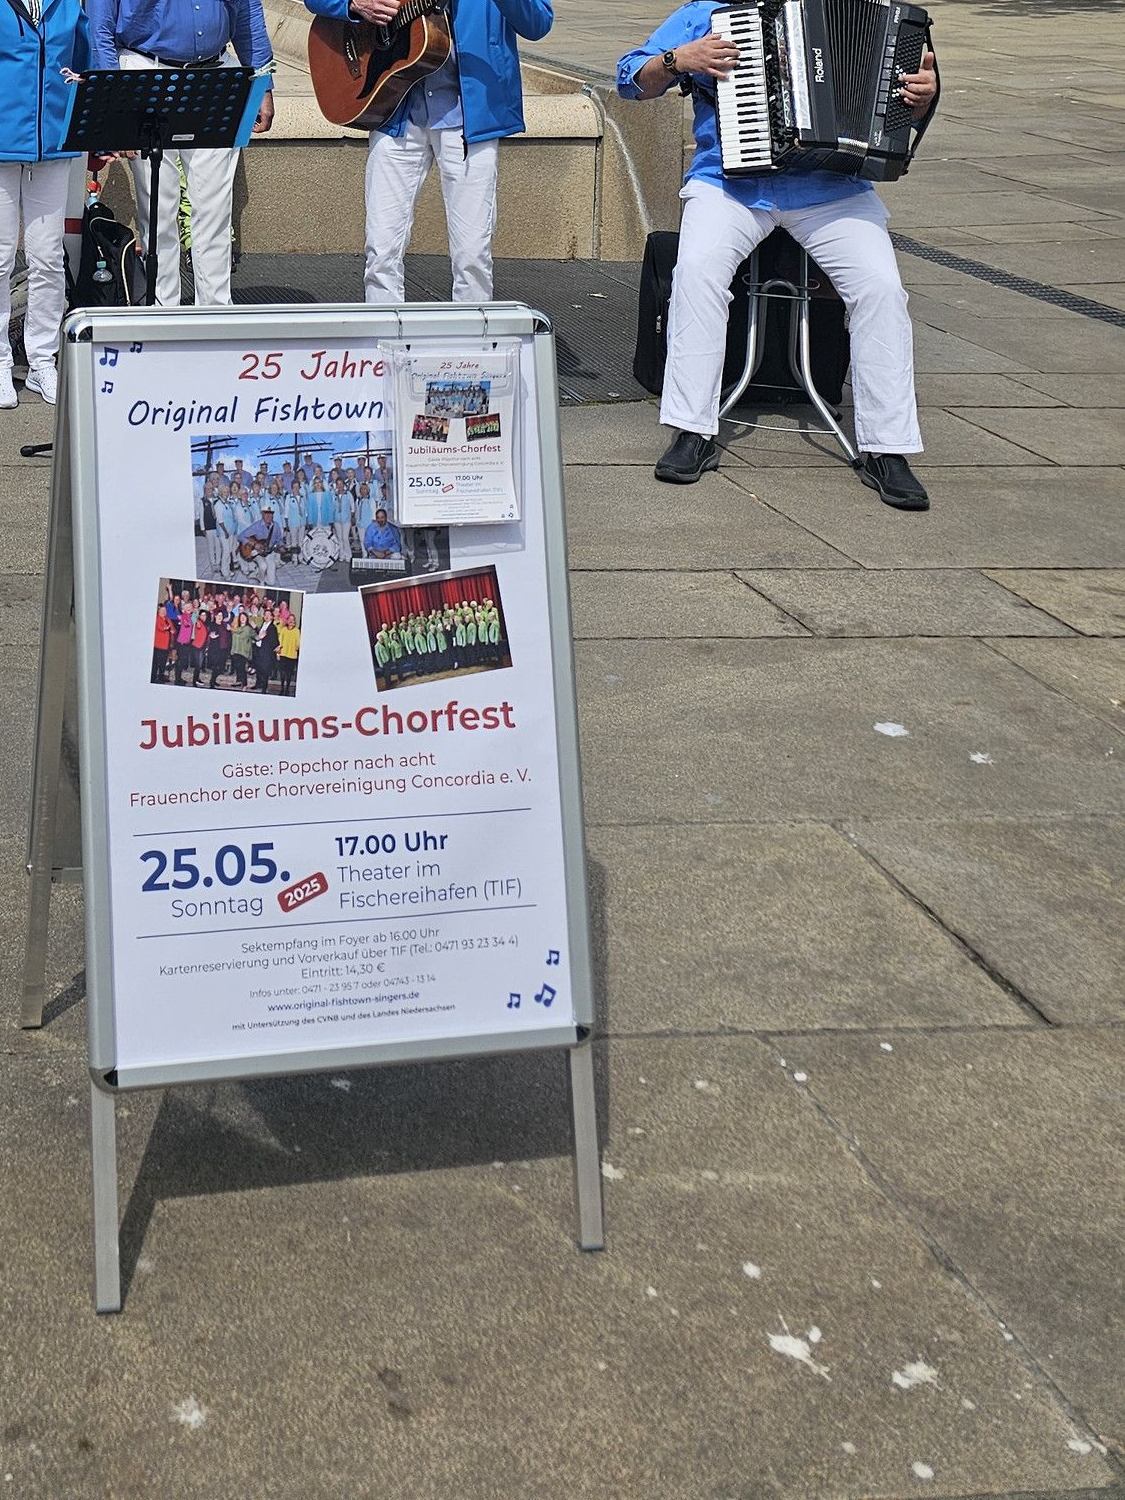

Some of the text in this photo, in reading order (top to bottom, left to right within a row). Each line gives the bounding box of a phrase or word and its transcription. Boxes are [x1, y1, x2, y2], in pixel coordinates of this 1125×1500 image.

[811, 47, 825, 83] Roland
[238, 350, 384, 380] 25 Jahre
[456, 361, 479, 369] Jahre
[128, 395, 384, 432] Original Fishtown
[408, 444, 501, 455] Jubiläums-Chorfest
[408, 476, 445, 488] 25.05.
[139, 701, 516, 749] Jubiläums-Chorfest
[222, 752, 436, 778] Gäste: Popchor nach acht
[130, 768, 531, 807] Frauenchor der Chorvereinigung Concordia e. V.
[335, 830, 448, 856] 17.00 Uhr
[139, 842, 290, 892] 25.05.
[337, 860, 441, 883] Theater im
[284, 878, 321, 907] 2025
[339, 877, 522, 909] Fischereihafen (TIF)
[171, 896, 263, 918] Sonntag
[241, 928, 440, 954] Sektempfang im Foyer ab 16.00 Uhr
[159, 958, 269, 976] Kartenreservierung
[272, 954, 295, 966] und
[298, 949, 358, 964] Vorverkauf
[361, 946, 387, 958] über
[391, 945, 409, 956] TIF
[434, 940, 459, 951] 0471
[462, 939, 474, 950] 93
[477, 937, 490, 948] 23
[301, 962, 386, 979] Eintritt: 14,30 €
[249, 988, 272, 998] Infos
[274, 987, 301, 997] unter:
[301, 984, 322, 994] 0471
[362, 980, 381, 989] oder
[267, 991, 420, 1012] www.original-fishtown-singers.de
[301, 1017, 315, 1025] des
[341, 1013, 356, 1021] und
[372, 1009, 399, 1018] Landes
[401, 1004, 456, 1015] Niedersachsen
